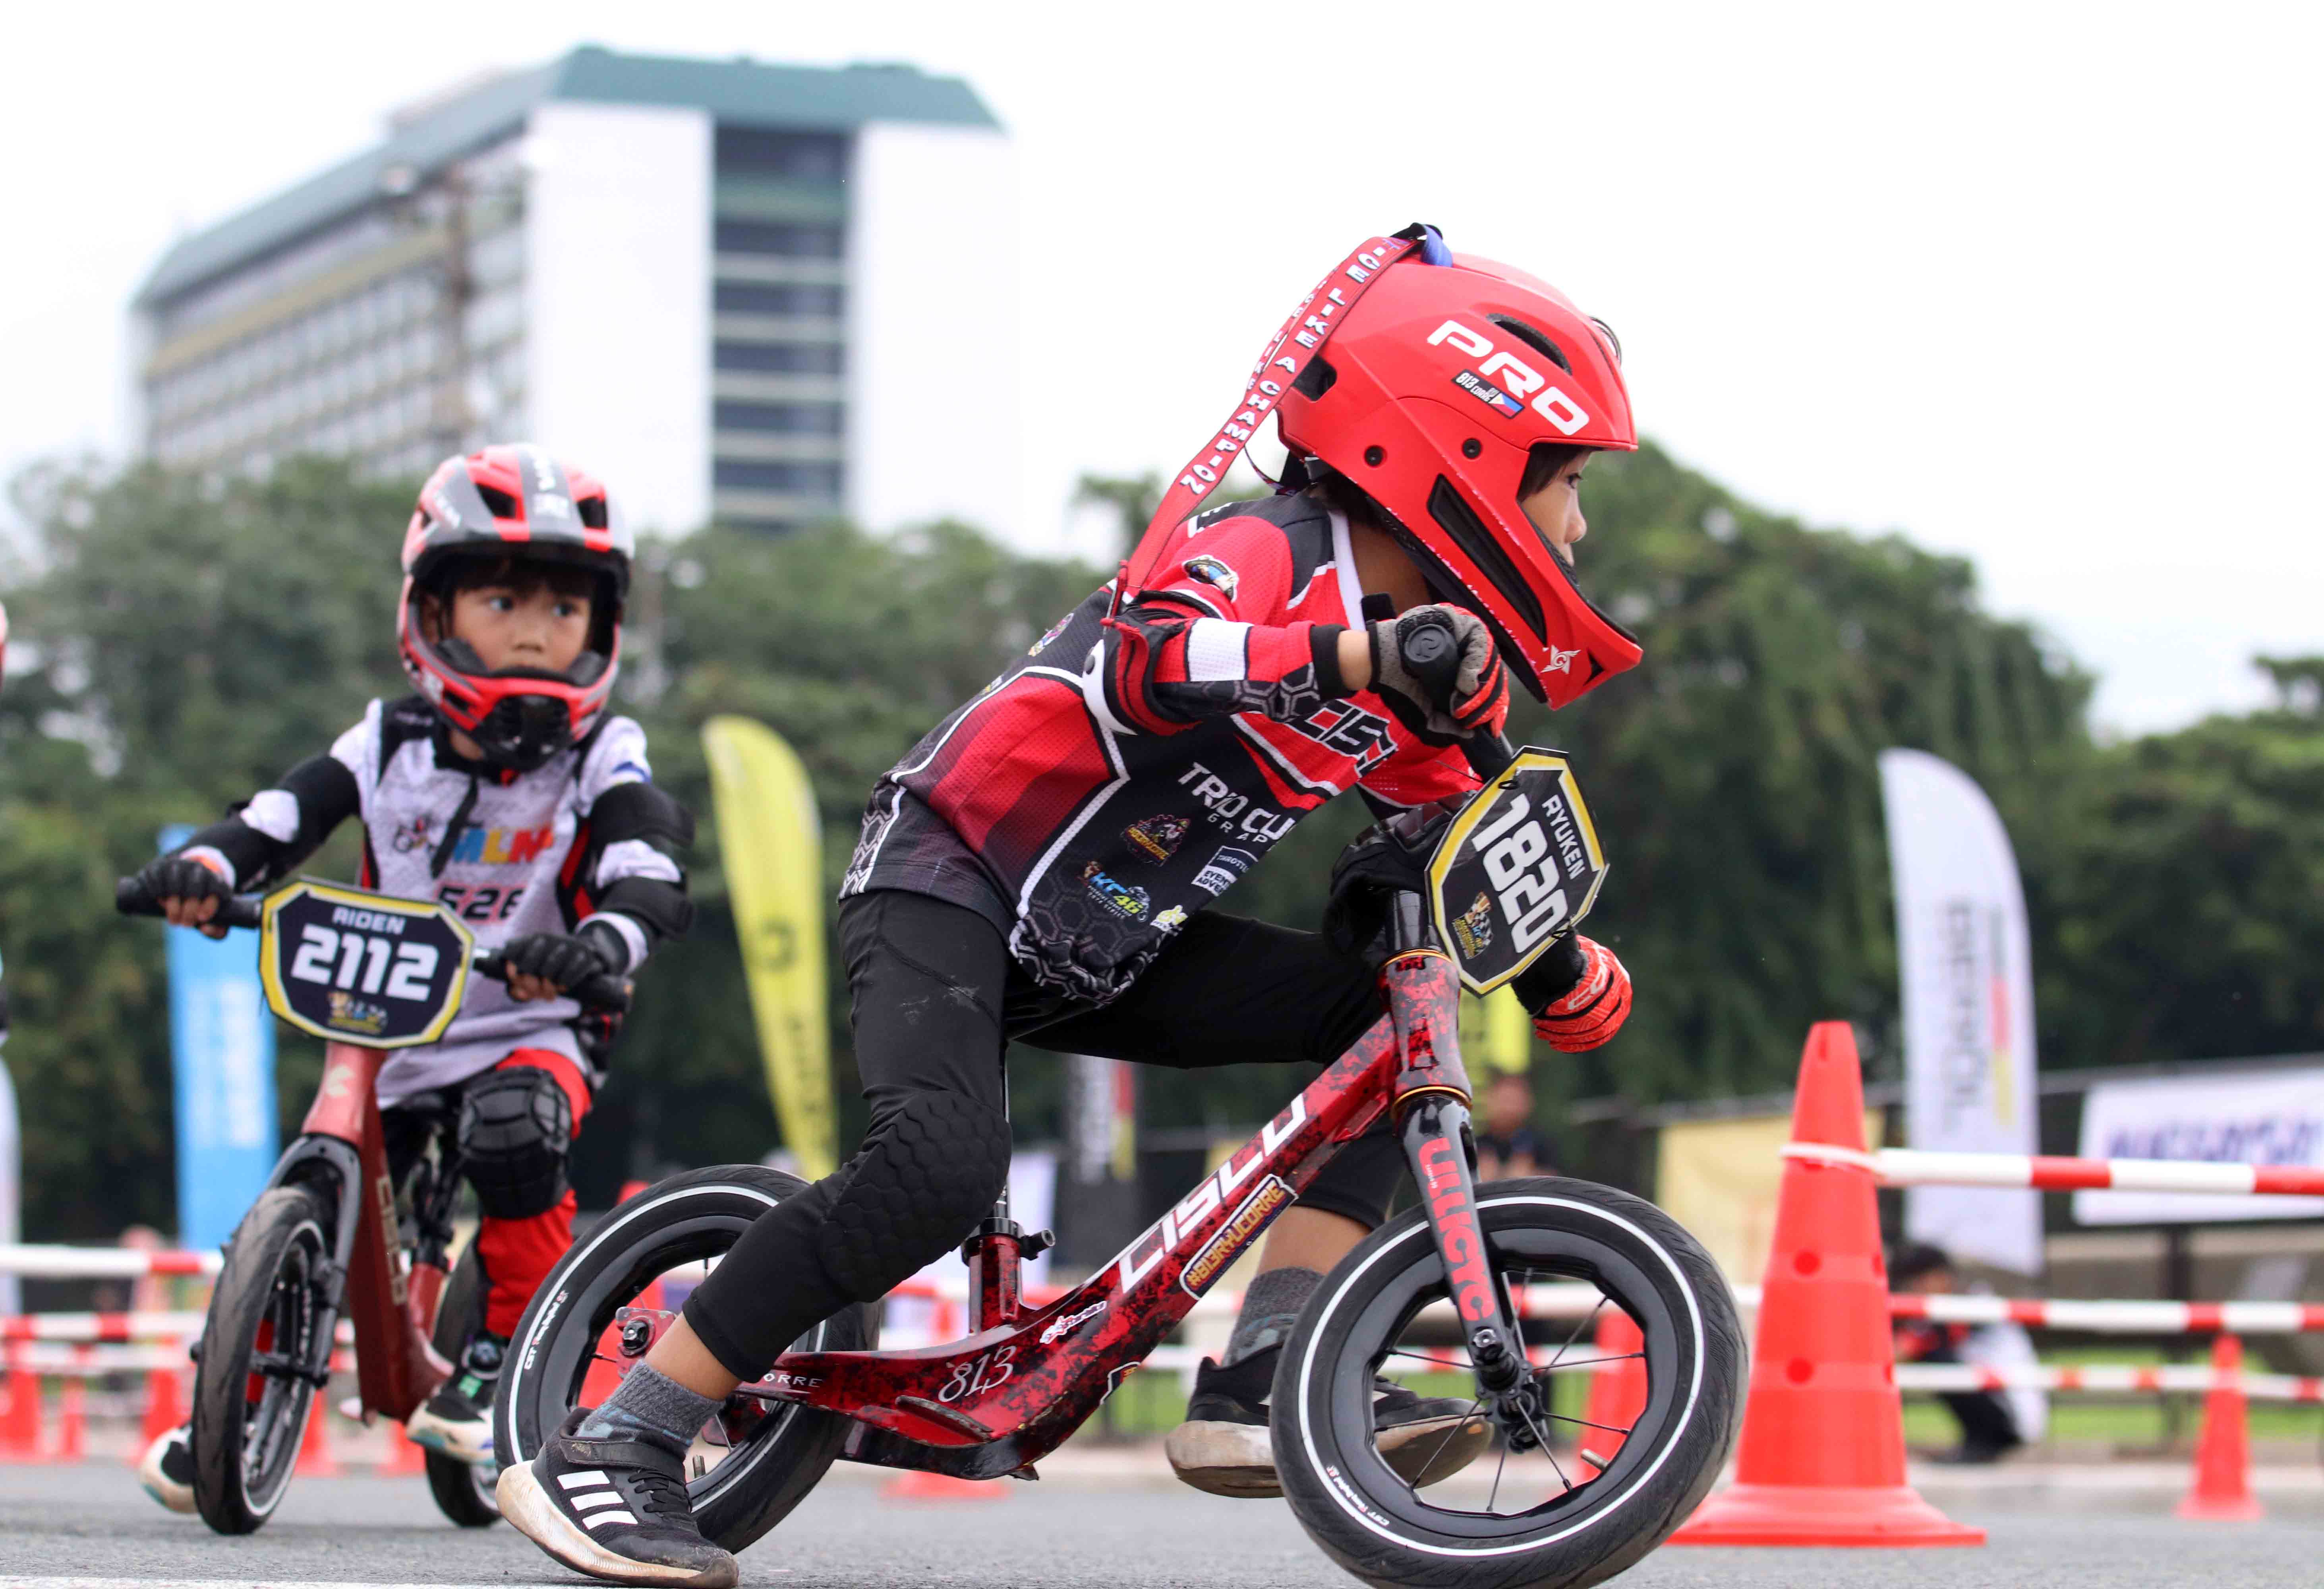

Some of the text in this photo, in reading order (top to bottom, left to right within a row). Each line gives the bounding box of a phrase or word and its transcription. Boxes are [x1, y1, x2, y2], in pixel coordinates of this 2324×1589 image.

[1294, 287, 1346, 349] LIKE
[1274, 356, 1295, 373] A
[1427, 319, 1590, 436] PRO
[1180, 379, 1282, 495] CHAMPION
[1471, 793, 1569, 953] 1820
[1542, 794, 1586, 880] RYUKEN
[290, 924, 440, 1001] 2112
[1418, 1137, 1496, 1321] ULLICYC
[763, 1372, 823, 1388] ORRE
[938, 1345, 1017, 1402] 813
